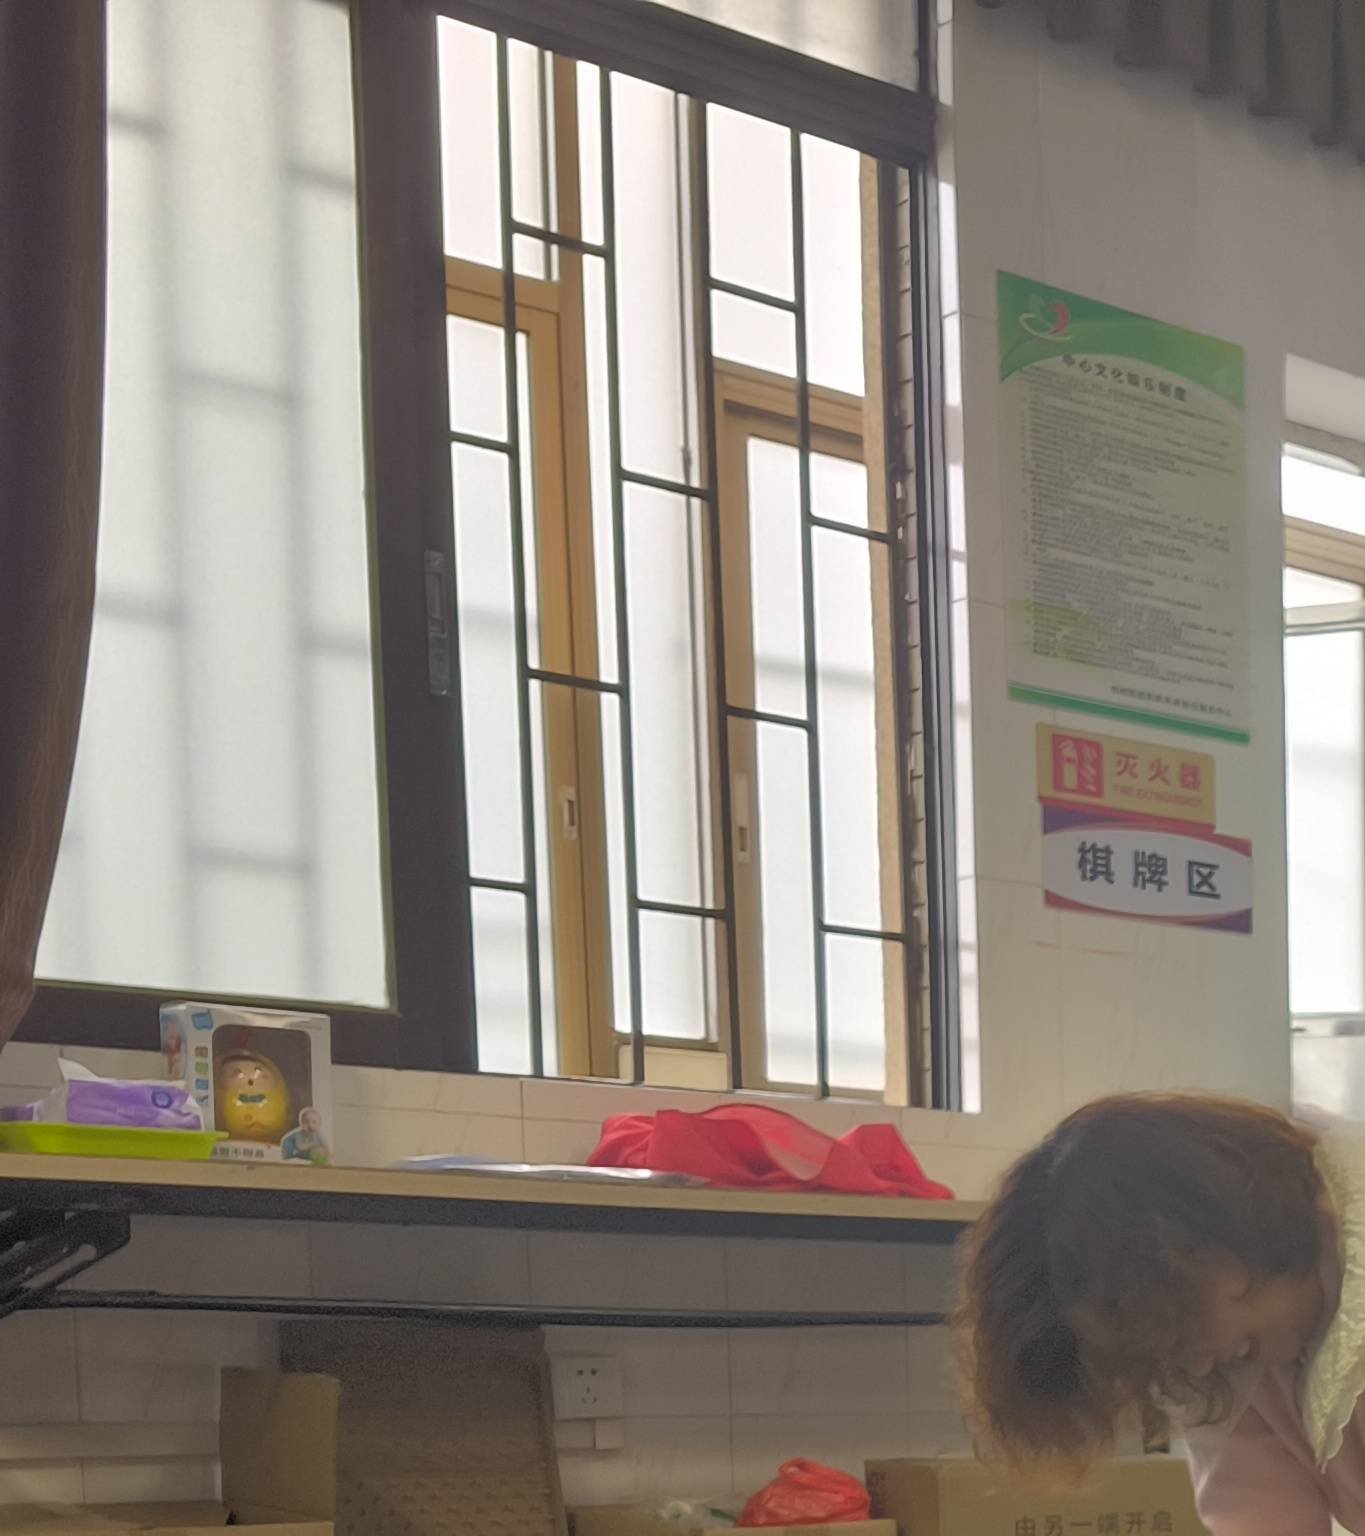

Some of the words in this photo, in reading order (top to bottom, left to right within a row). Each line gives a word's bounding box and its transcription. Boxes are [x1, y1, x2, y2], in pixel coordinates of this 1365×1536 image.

[1115, 751, 1202, 791] 灭火器
[1076, 840, 1221, 900] 棋牌区
